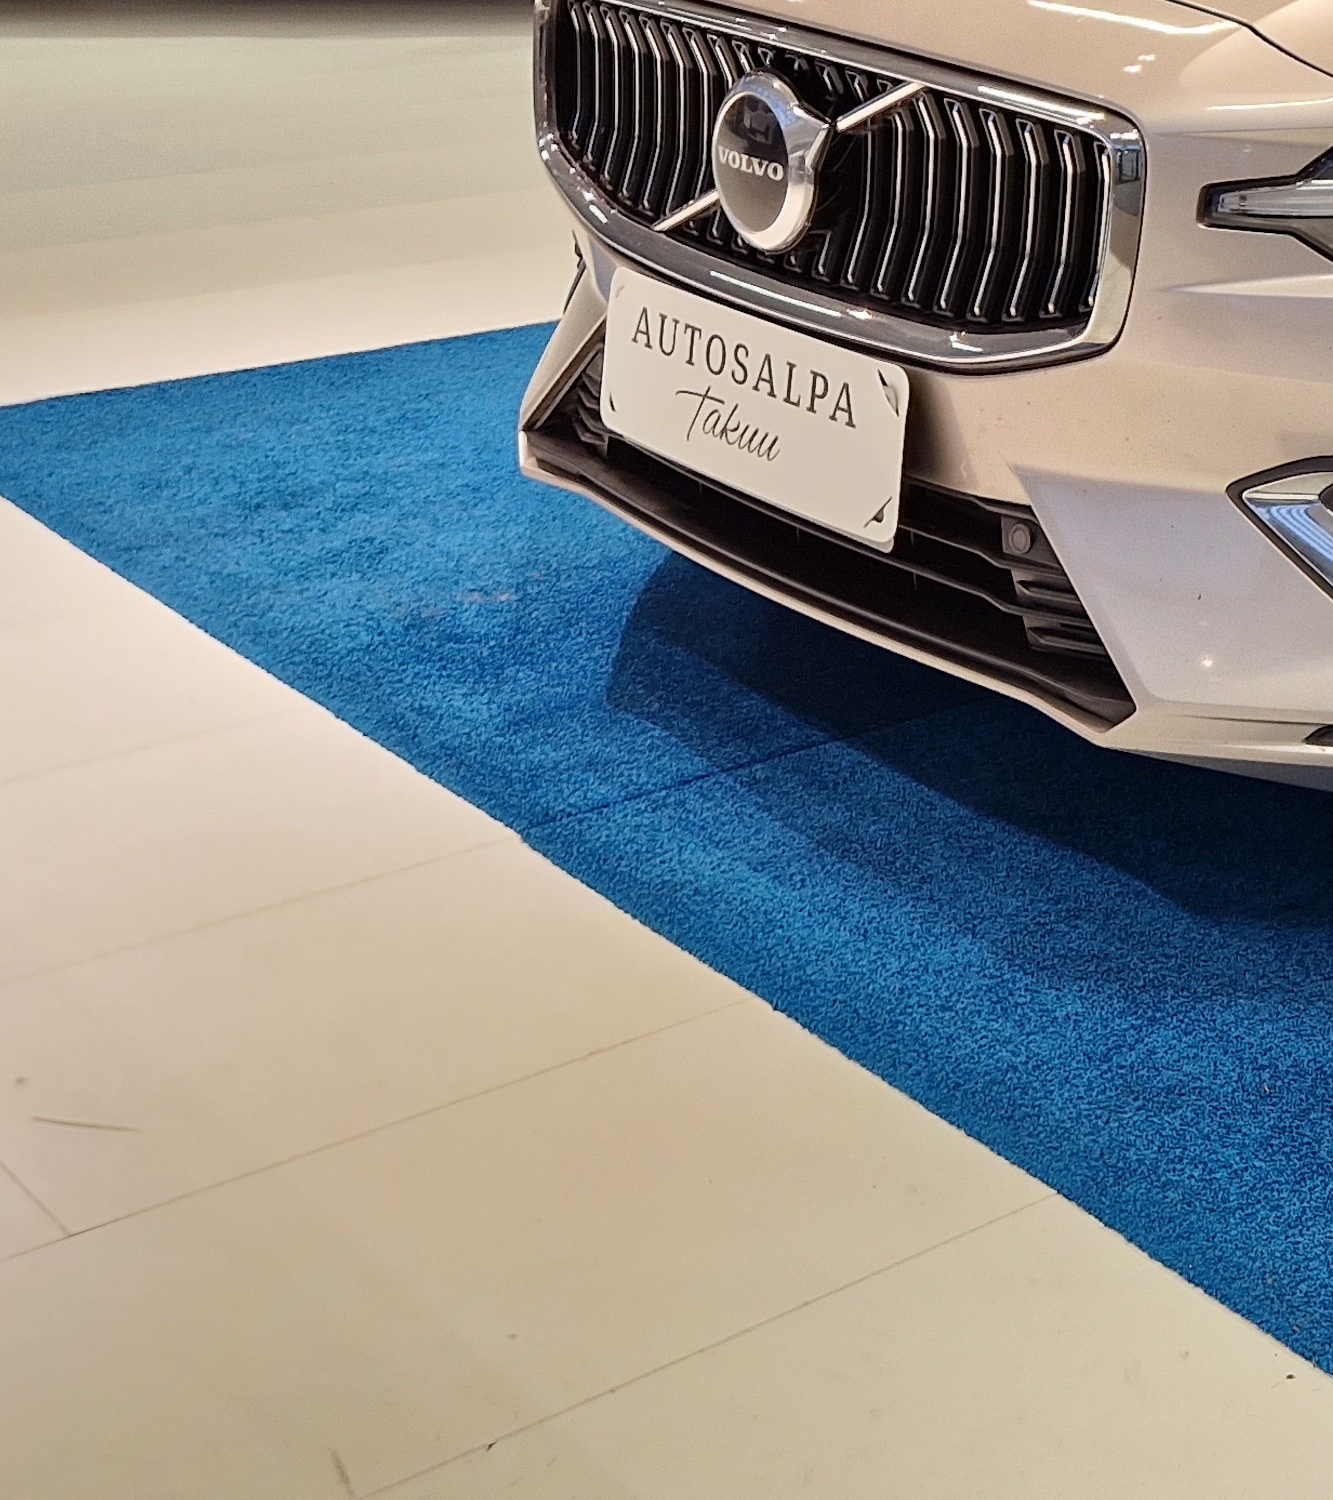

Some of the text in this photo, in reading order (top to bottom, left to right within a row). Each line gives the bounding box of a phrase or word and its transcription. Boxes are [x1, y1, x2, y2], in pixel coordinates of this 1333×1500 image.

[718, 145, 784, 181] VOLVO
[631, 306, 856, 429] AUTOSALPA
[675, 385, 781, 462] Takuu
